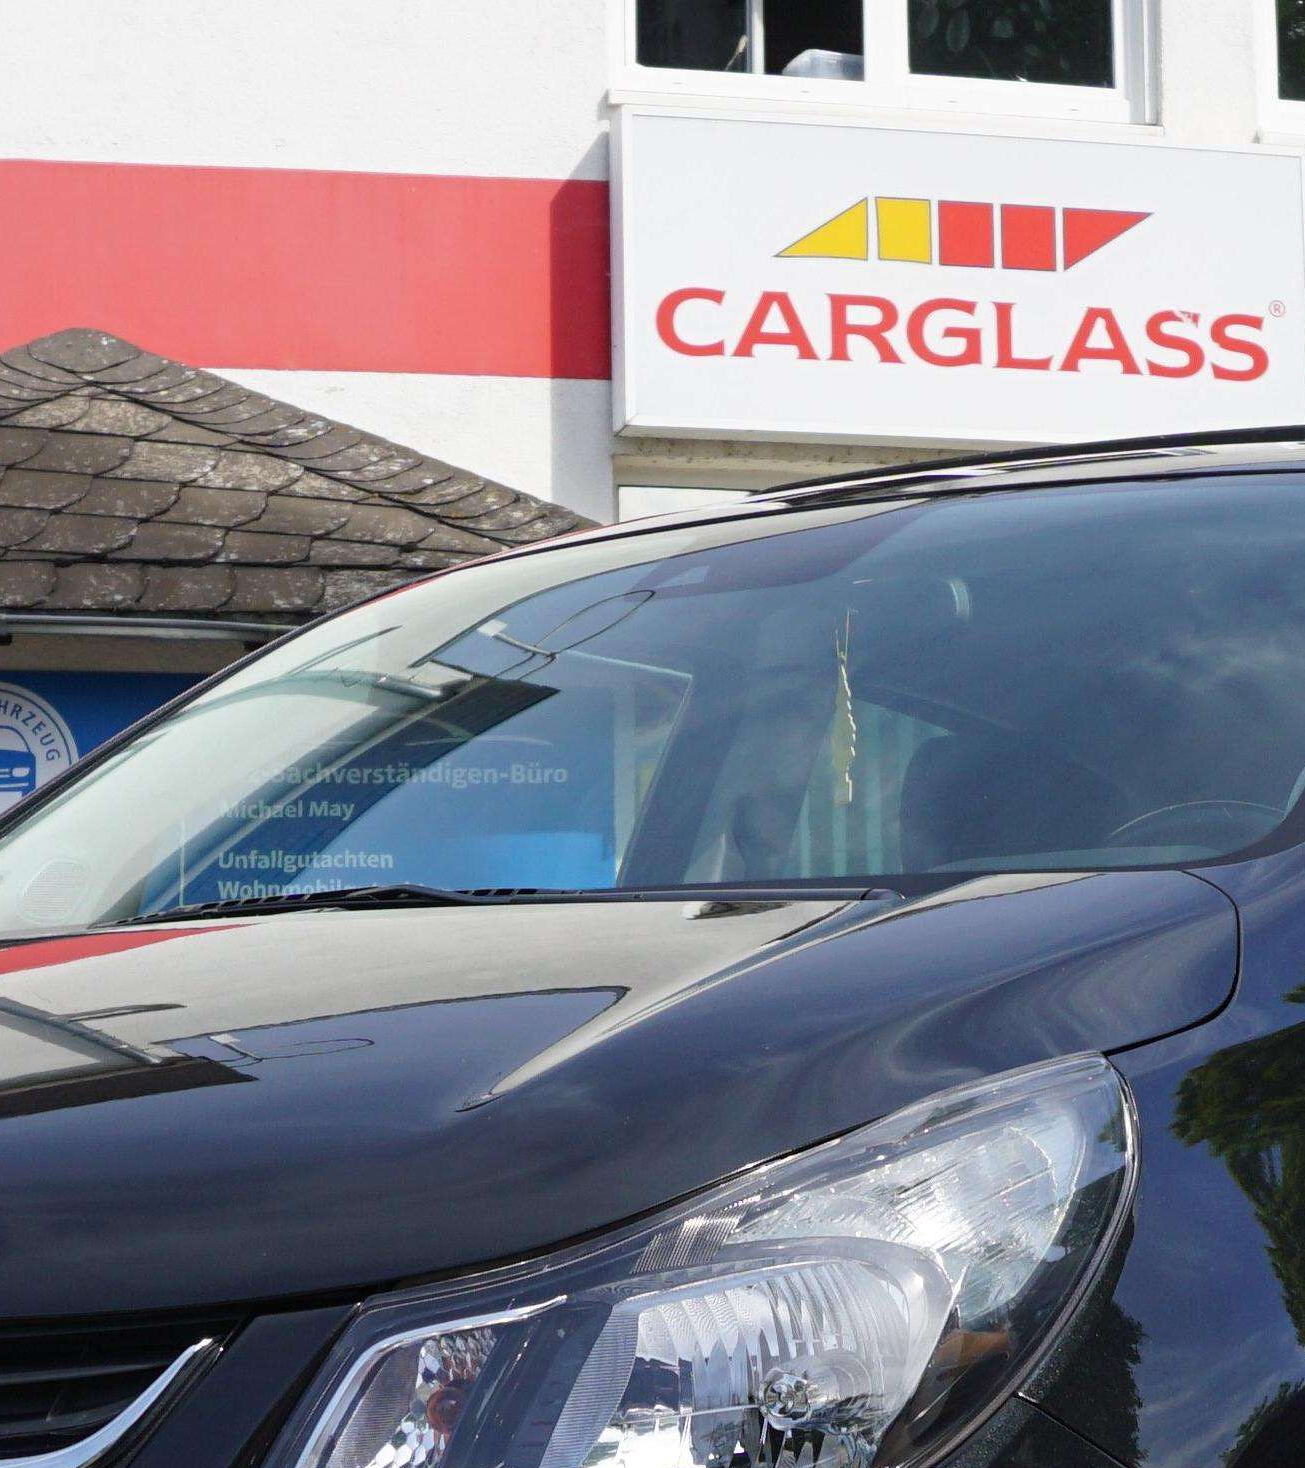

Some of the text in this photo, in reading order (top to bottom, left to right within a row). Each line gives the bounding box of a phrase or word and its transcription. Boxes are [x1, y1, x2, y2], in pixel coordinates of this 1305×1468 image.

[655, 286, 1269, 382] CARGLASS
[309, 800, 355, 821] May
[217, 849, 394, 874] Unfallgutachten
